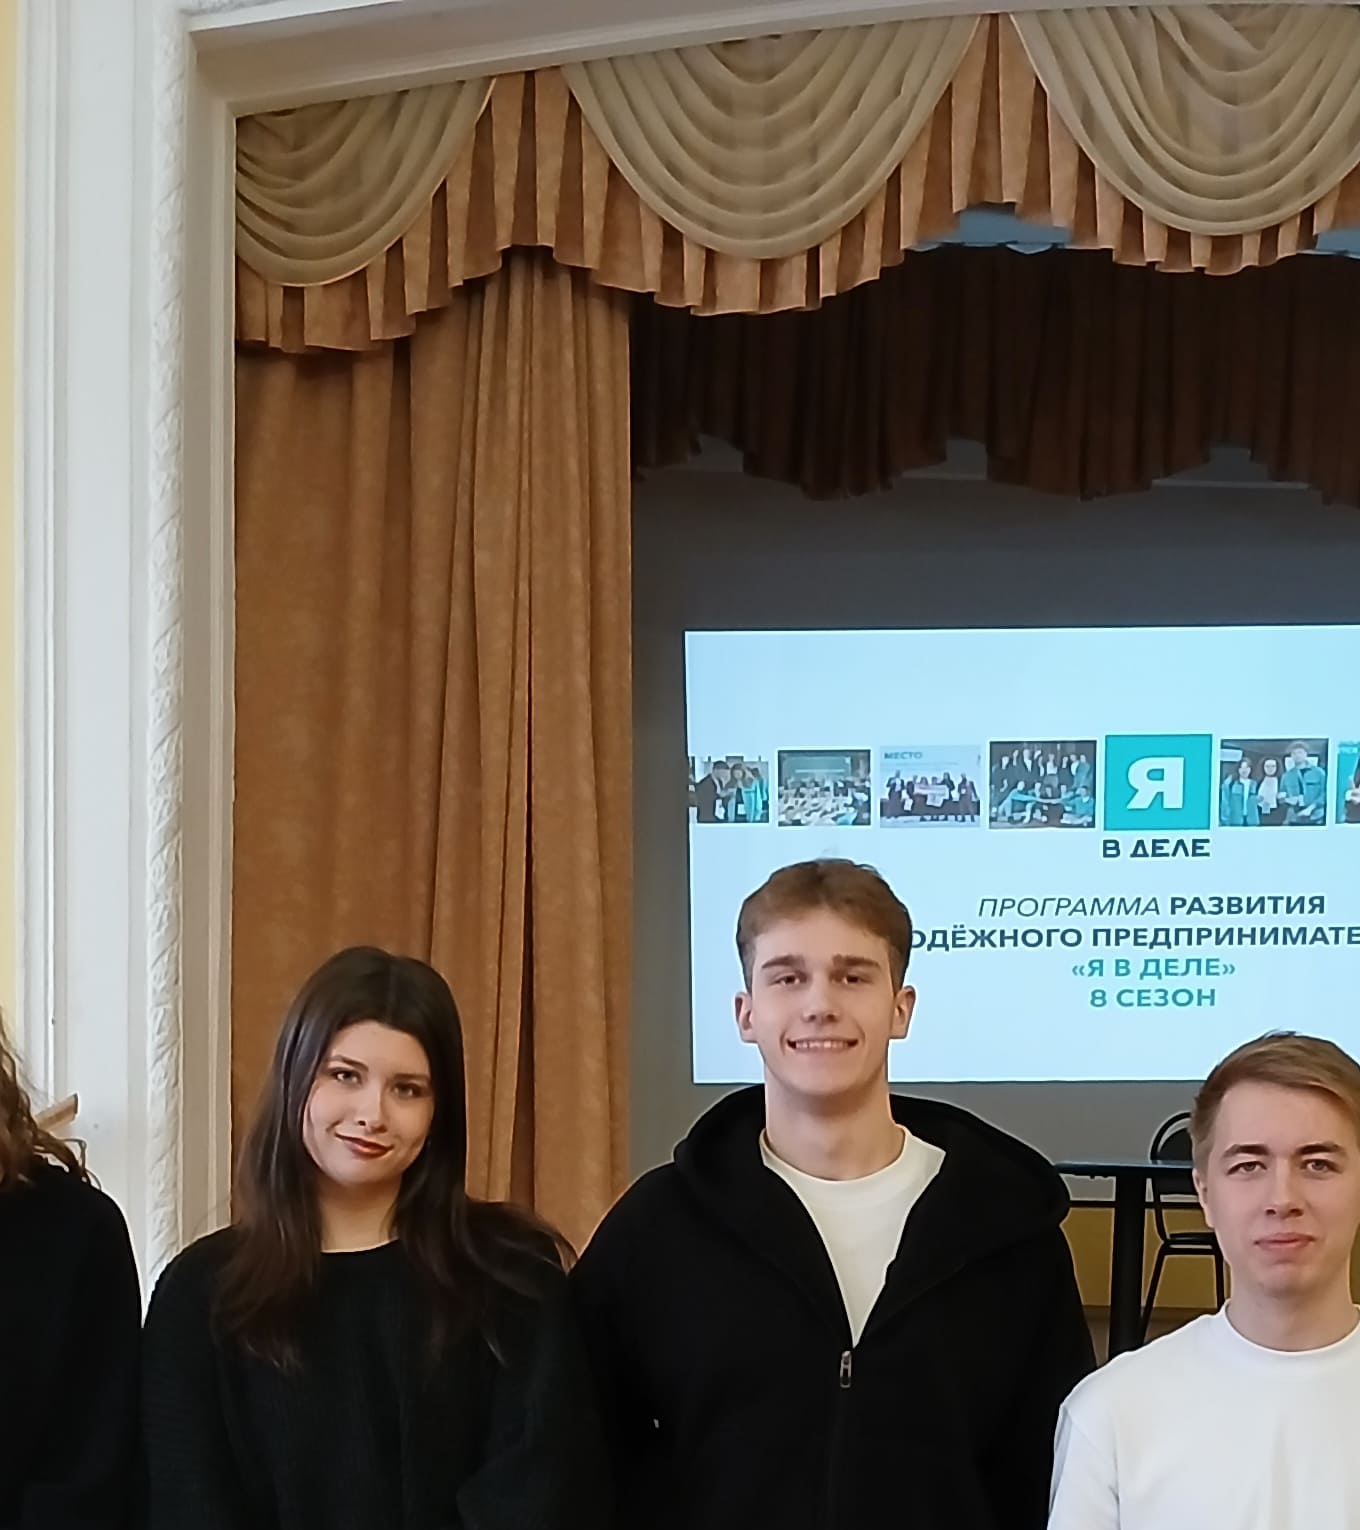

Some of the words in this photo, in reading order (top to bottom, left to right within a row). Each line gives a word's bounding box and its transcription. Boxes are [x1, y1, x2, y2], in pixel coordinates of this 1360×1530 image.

[1127, 756, 1185, 809] Я
[1103, 839, 1120, 858] В
[1129, 838, 1210, 858] ДЕЛЕ
[978, 897, 1160, 917] ПРОГРАММА
[1170, 895, 1325, 916] РАЗВИТИЯ
[911, 924, 1082, 951] ОДЁЖНОГО
[1072, 959, 1104, 977] «Я
[1114, 959, 1131, 976] В
[1140, 957, 1236, 979] ДЕЛЕ»
[1090, 989, 1107, 1007] 8
[1116, 988, 1216, 1007] СЕЗОН
